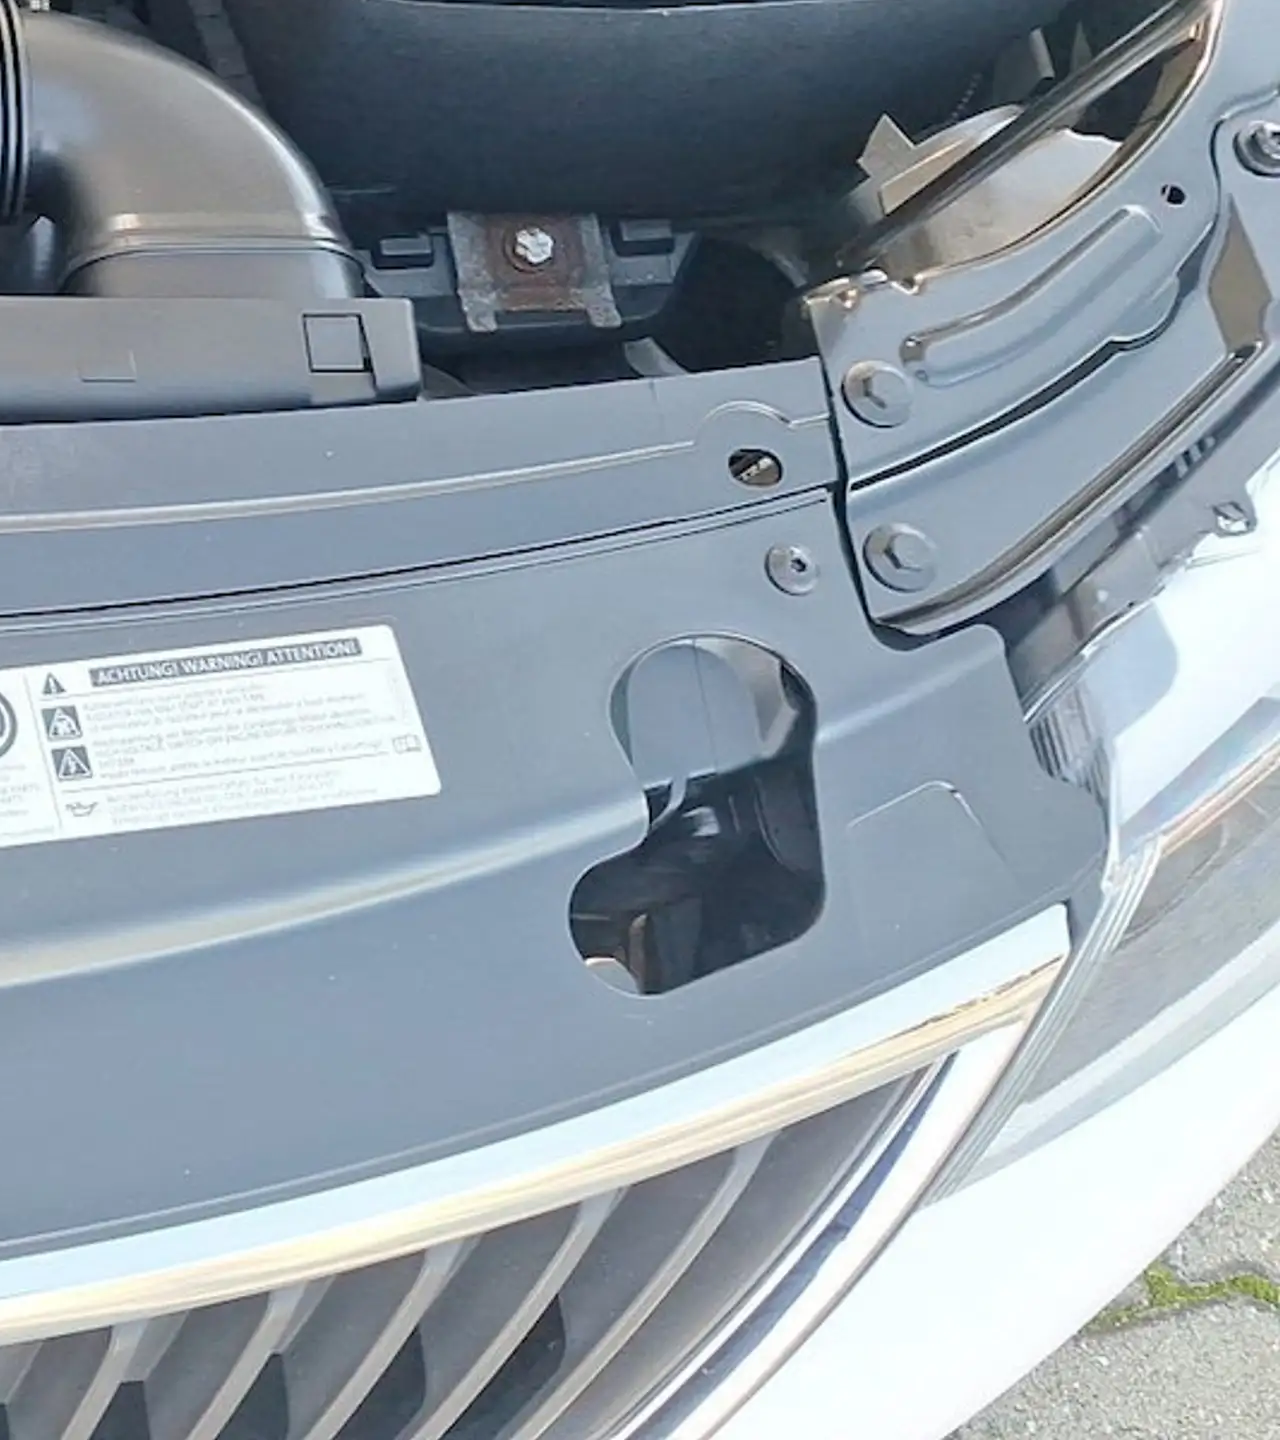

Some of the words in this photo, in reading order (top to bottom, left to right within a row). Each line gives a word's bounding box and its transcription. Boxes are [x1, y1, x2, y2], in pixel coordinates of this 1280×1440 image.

[96, 661, 180, 685] ACHTUNG!
[181, 651, 264, 675] WARNING!
[266, 641, 358, 666] ATTENTION!
